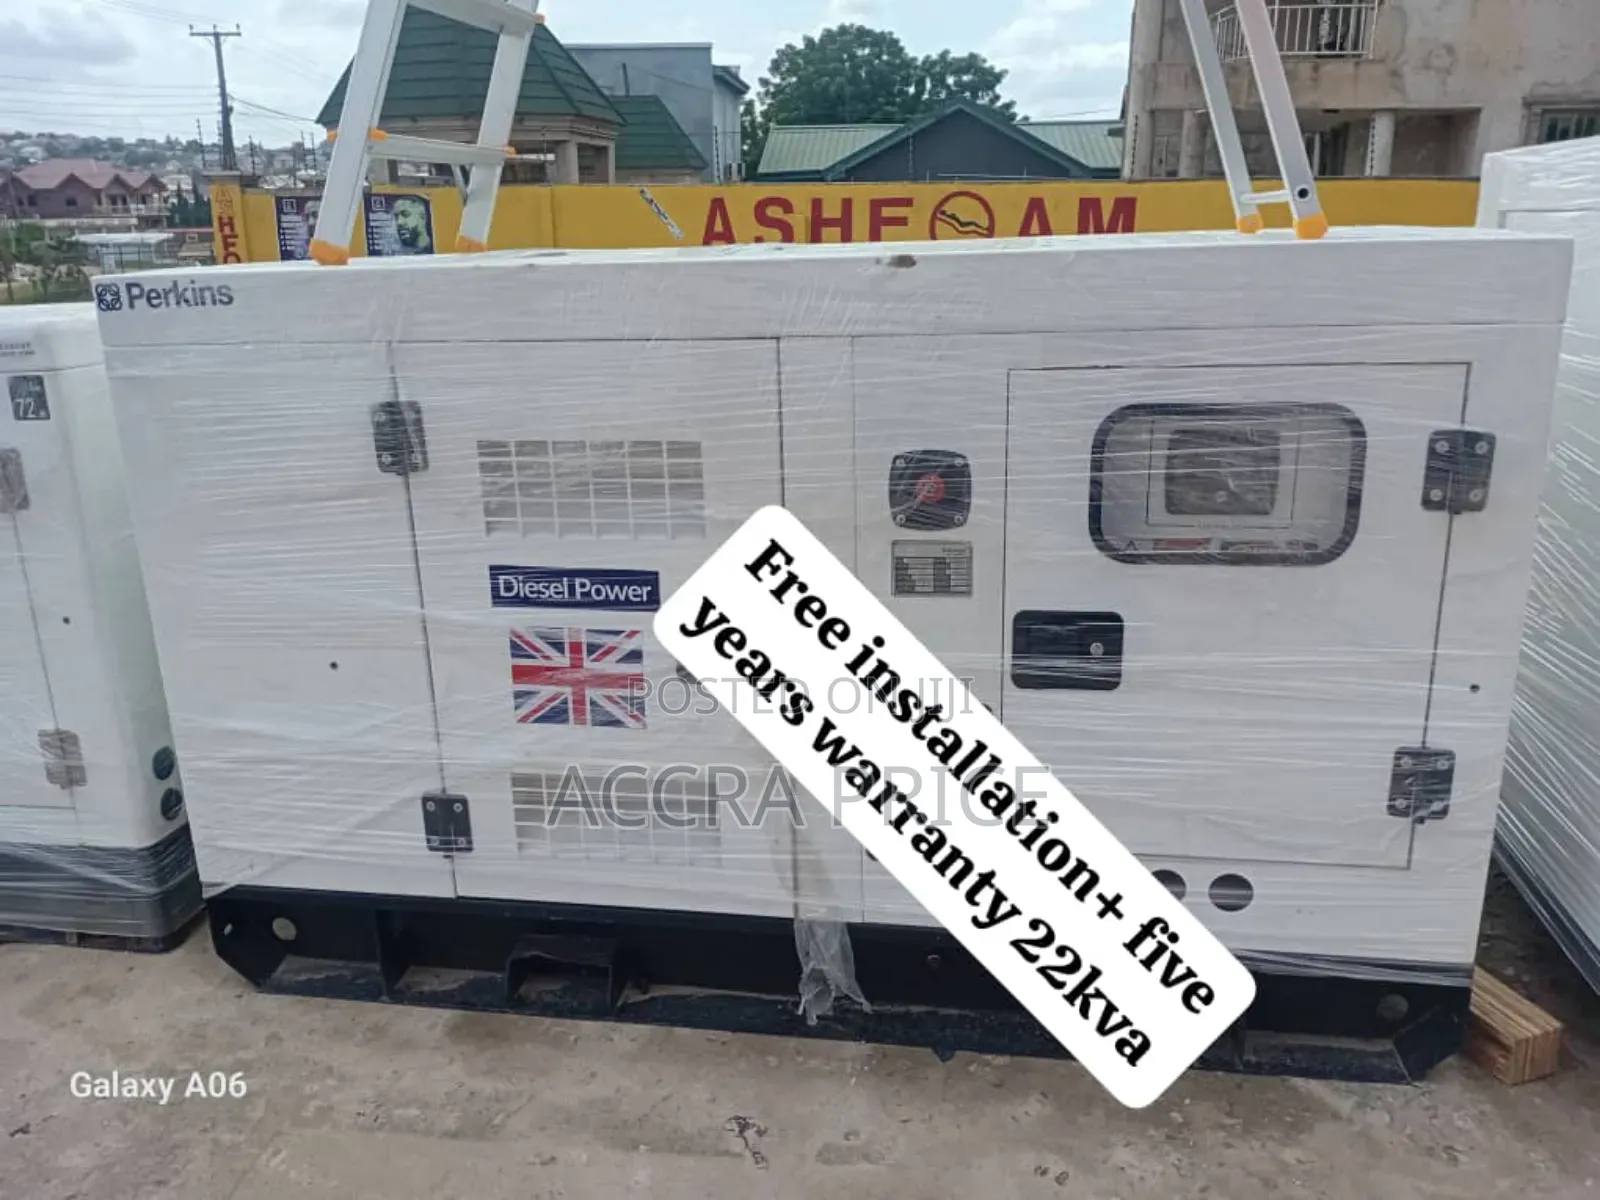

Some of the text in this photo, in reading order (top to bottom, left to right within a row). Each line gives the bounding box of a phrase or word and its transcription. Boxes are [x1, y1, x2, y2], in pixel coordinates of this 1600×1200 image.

[125, 279, 235, 310] Perkins
[498, 575, 652, 602] Diesel Power
